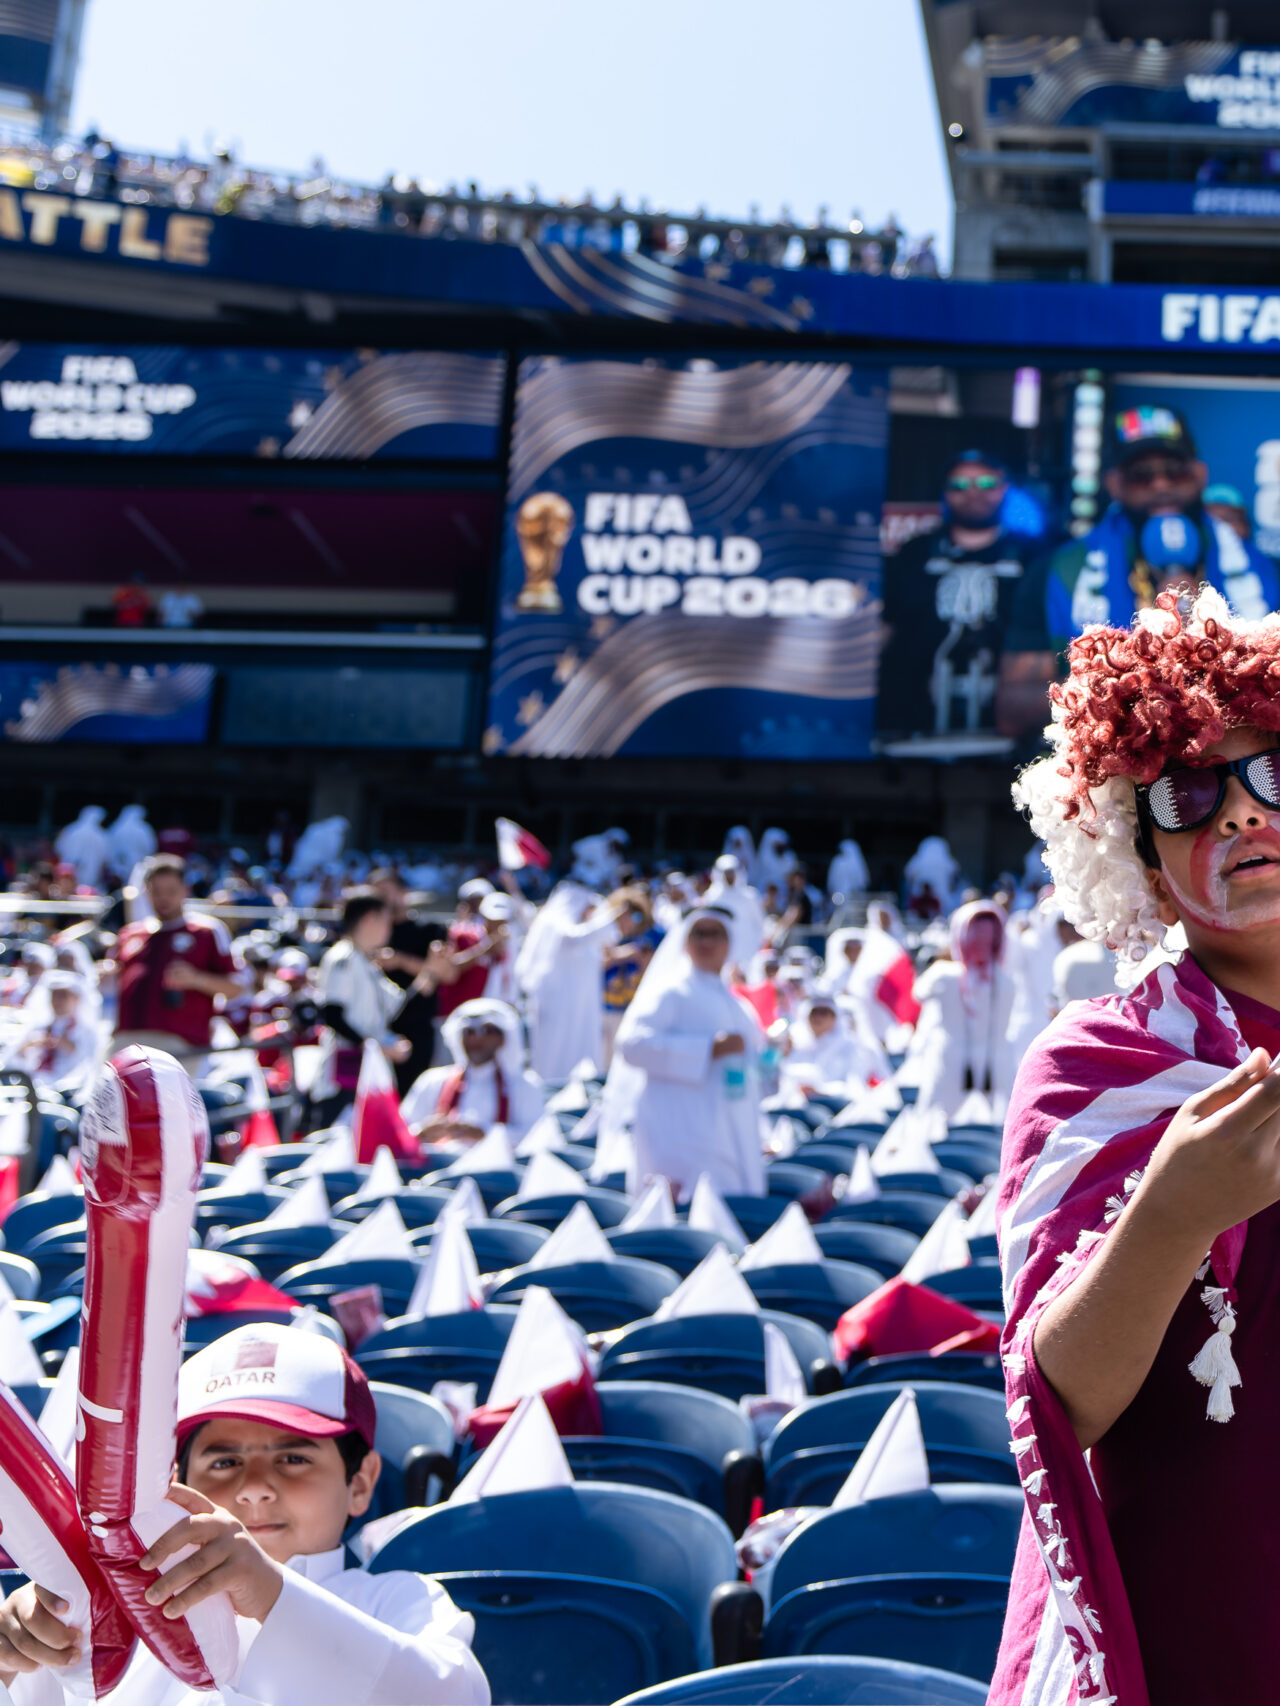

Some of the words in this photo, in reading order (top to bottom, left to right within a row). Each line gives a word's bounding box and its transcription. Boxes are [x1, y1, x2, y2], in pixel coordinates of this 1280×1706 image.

[62, 355, 138, 384] FIFA
[1, 381, 124, 411] WORLD
[125, 382, 196, 414] CUP
[30, 411, 153, 440] 2026
[584, 492, 692, 534] FIFA
[581, 533, 761, 576] WORLD
[577, 573, 680, 615] CUP
[681, 576, 856, 618] 2026
[205, 1371, 276, 1393] QATAR
